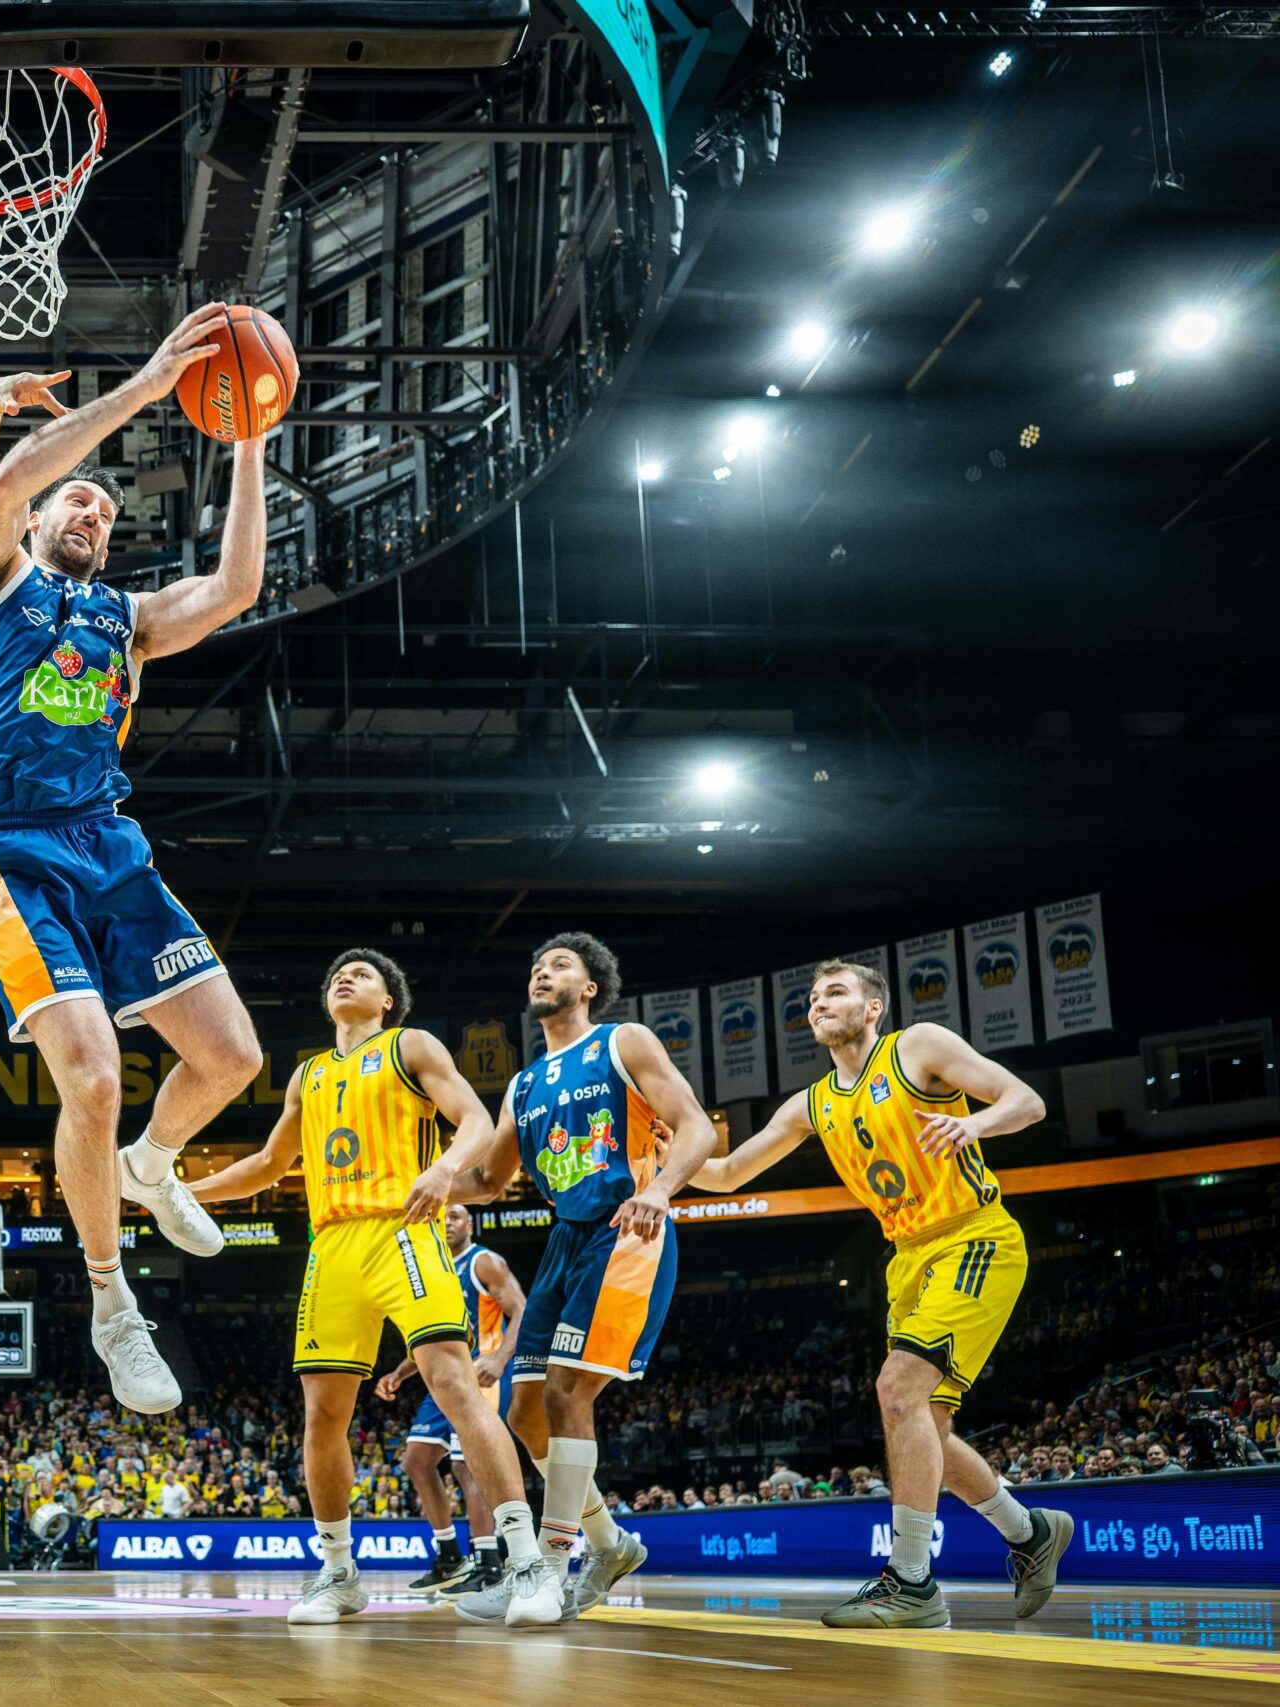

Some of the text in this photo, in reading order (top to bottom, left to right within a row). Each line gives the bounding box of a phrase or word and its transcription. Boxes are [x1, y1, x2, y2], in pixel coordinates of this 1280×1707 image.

[27, 675, 108, 712] Karls
[546, 1058, 563, 1085] 5
[336, 1080, 347, 1114] 7
[573, 1082, 611, 1101] OSPA
[853, 1116, 874, 1150] 6
[322, 1169, 376, 1187] chindler
[21, 1227, 62, 1242] ROSTOCK
[551, 1331, 585, 1353] IRO
[112, 1536, 183, 1559] ALBA
[234, 1536, 305, 1559] ALBA
[357, 1536, 428, 1559] ALBA
[1083, 1515, 1264, 1558] Let's go, Team!
